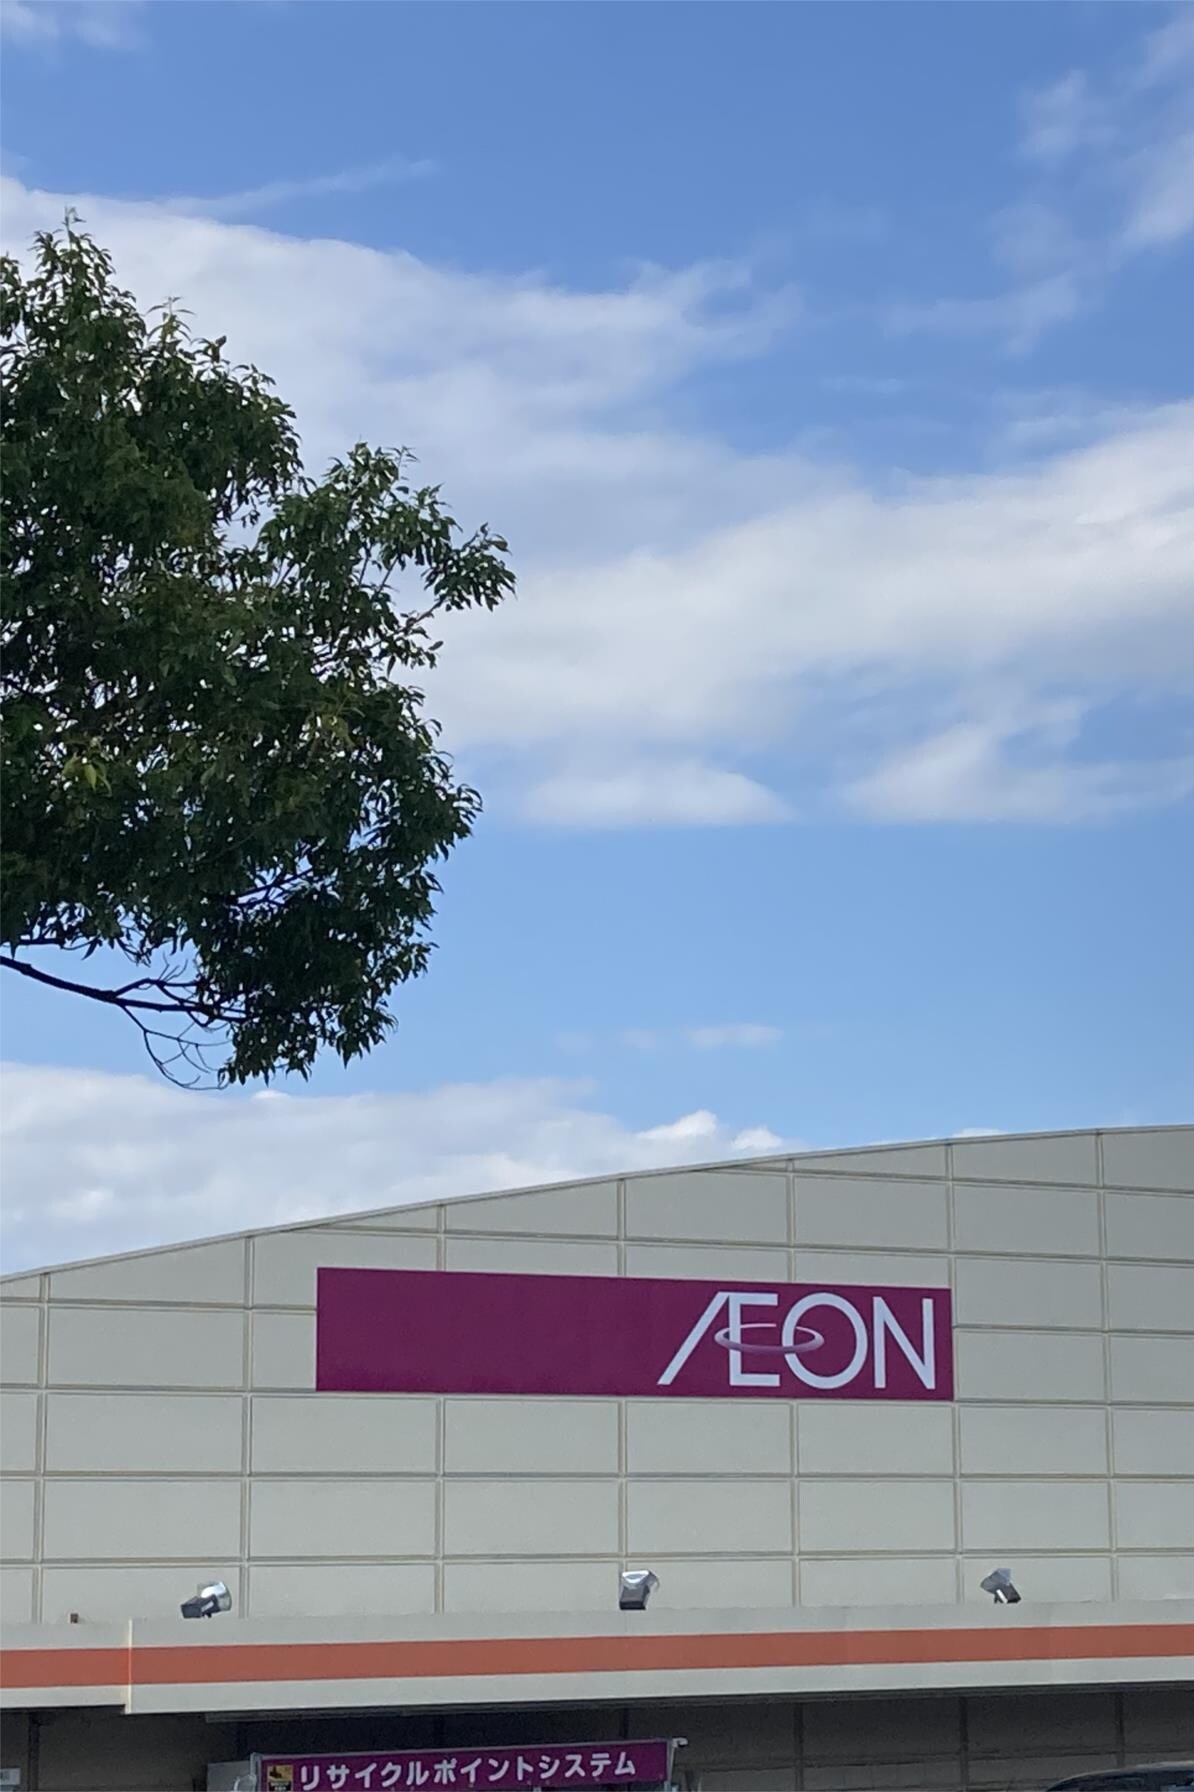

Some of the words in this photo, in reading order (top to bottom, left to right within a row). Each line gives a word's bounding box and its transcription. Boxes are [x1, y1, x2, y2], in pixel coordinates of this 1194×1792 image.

[300, 1751, 636, 1791] リサイクルポイントシステム
